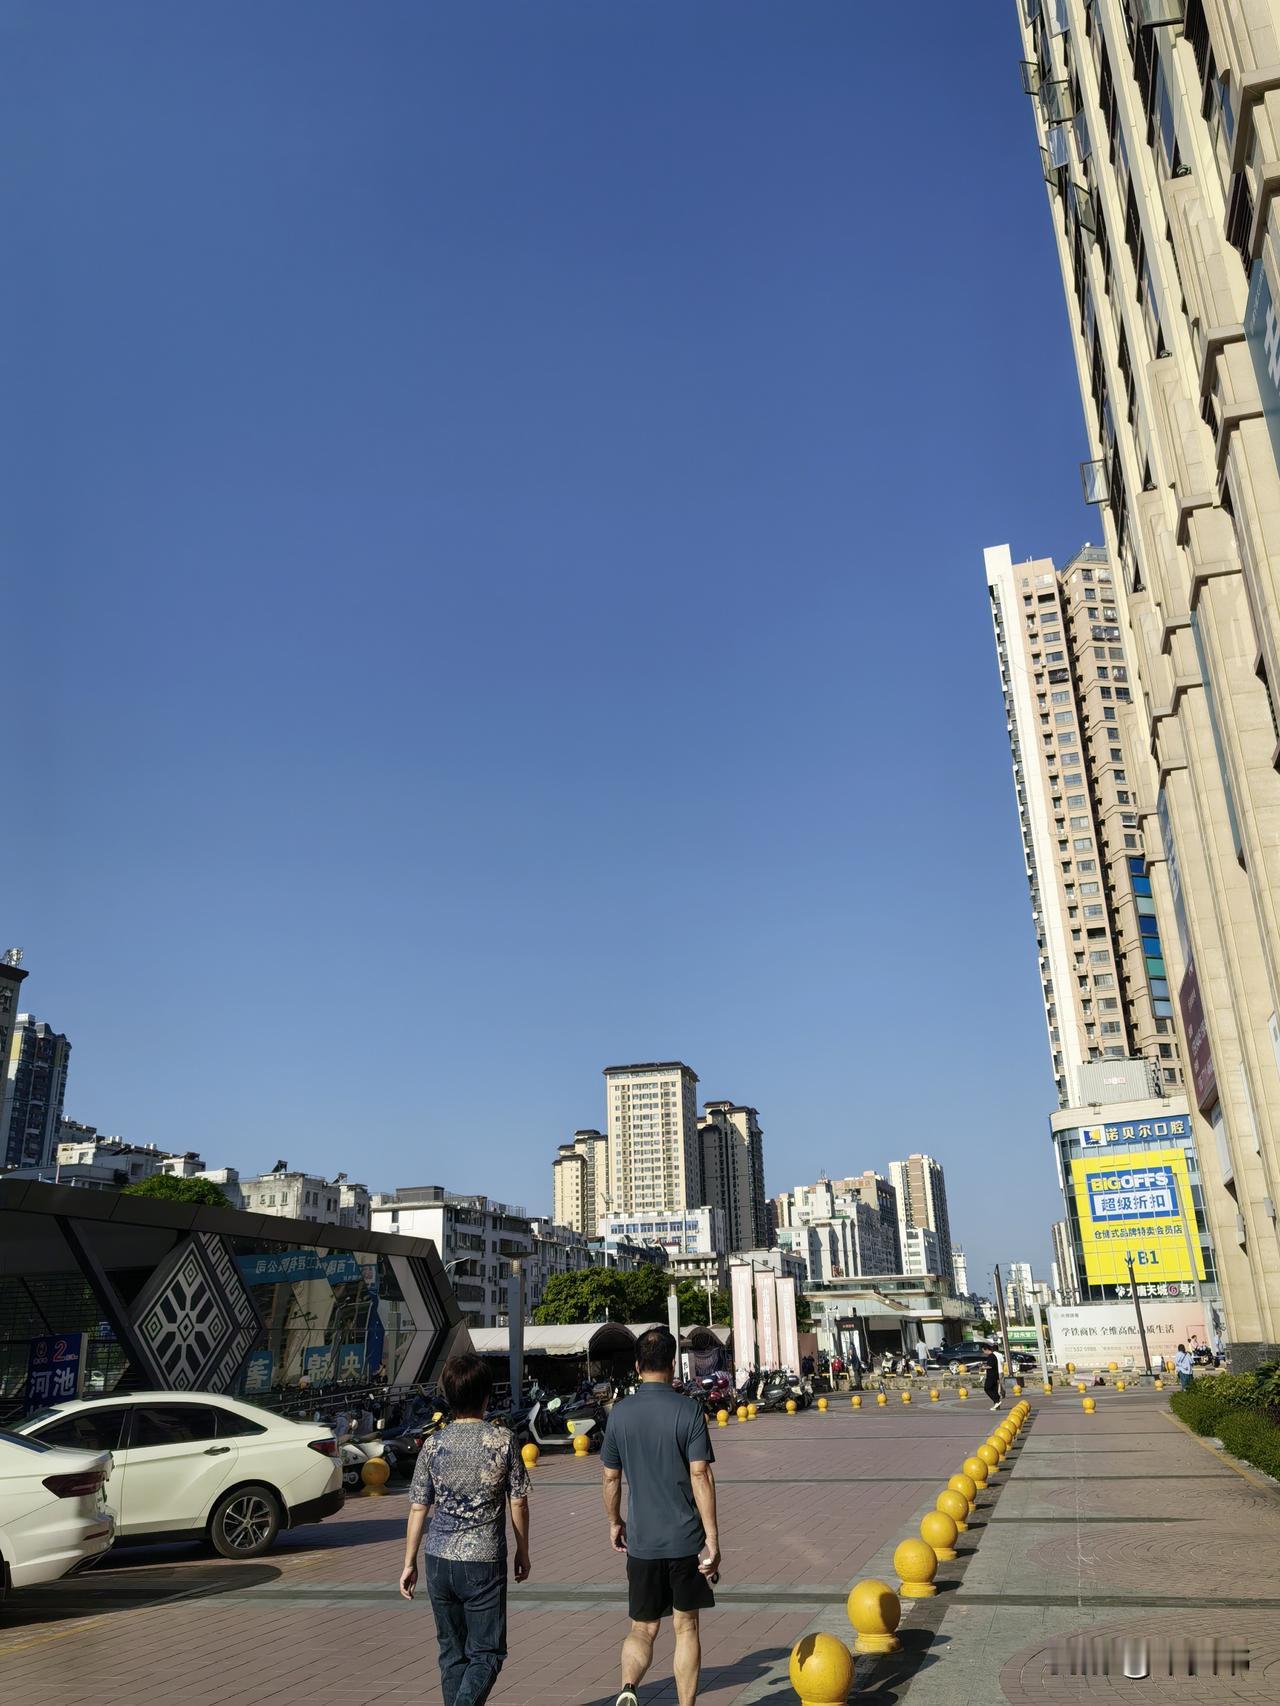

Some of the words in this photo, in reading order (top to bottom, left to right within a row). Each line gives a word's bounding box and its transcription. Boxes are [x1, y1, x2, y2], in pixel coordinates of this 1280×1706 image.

[1105, 1120, 1185, 1142] 诺贝尔口腔
[1090, 1171, 1169, 1193] BIGOFFS
[1101, 1194, 1166, 1212] 超级折扣
[1094, 1224, 1183, 1240] 仓储式品牌特卖会员店
[1137, 1250, 1160, 1266] B1
[52, 1339, 68, 1362] 2
[28, 1367, 76, 1399] 河池
